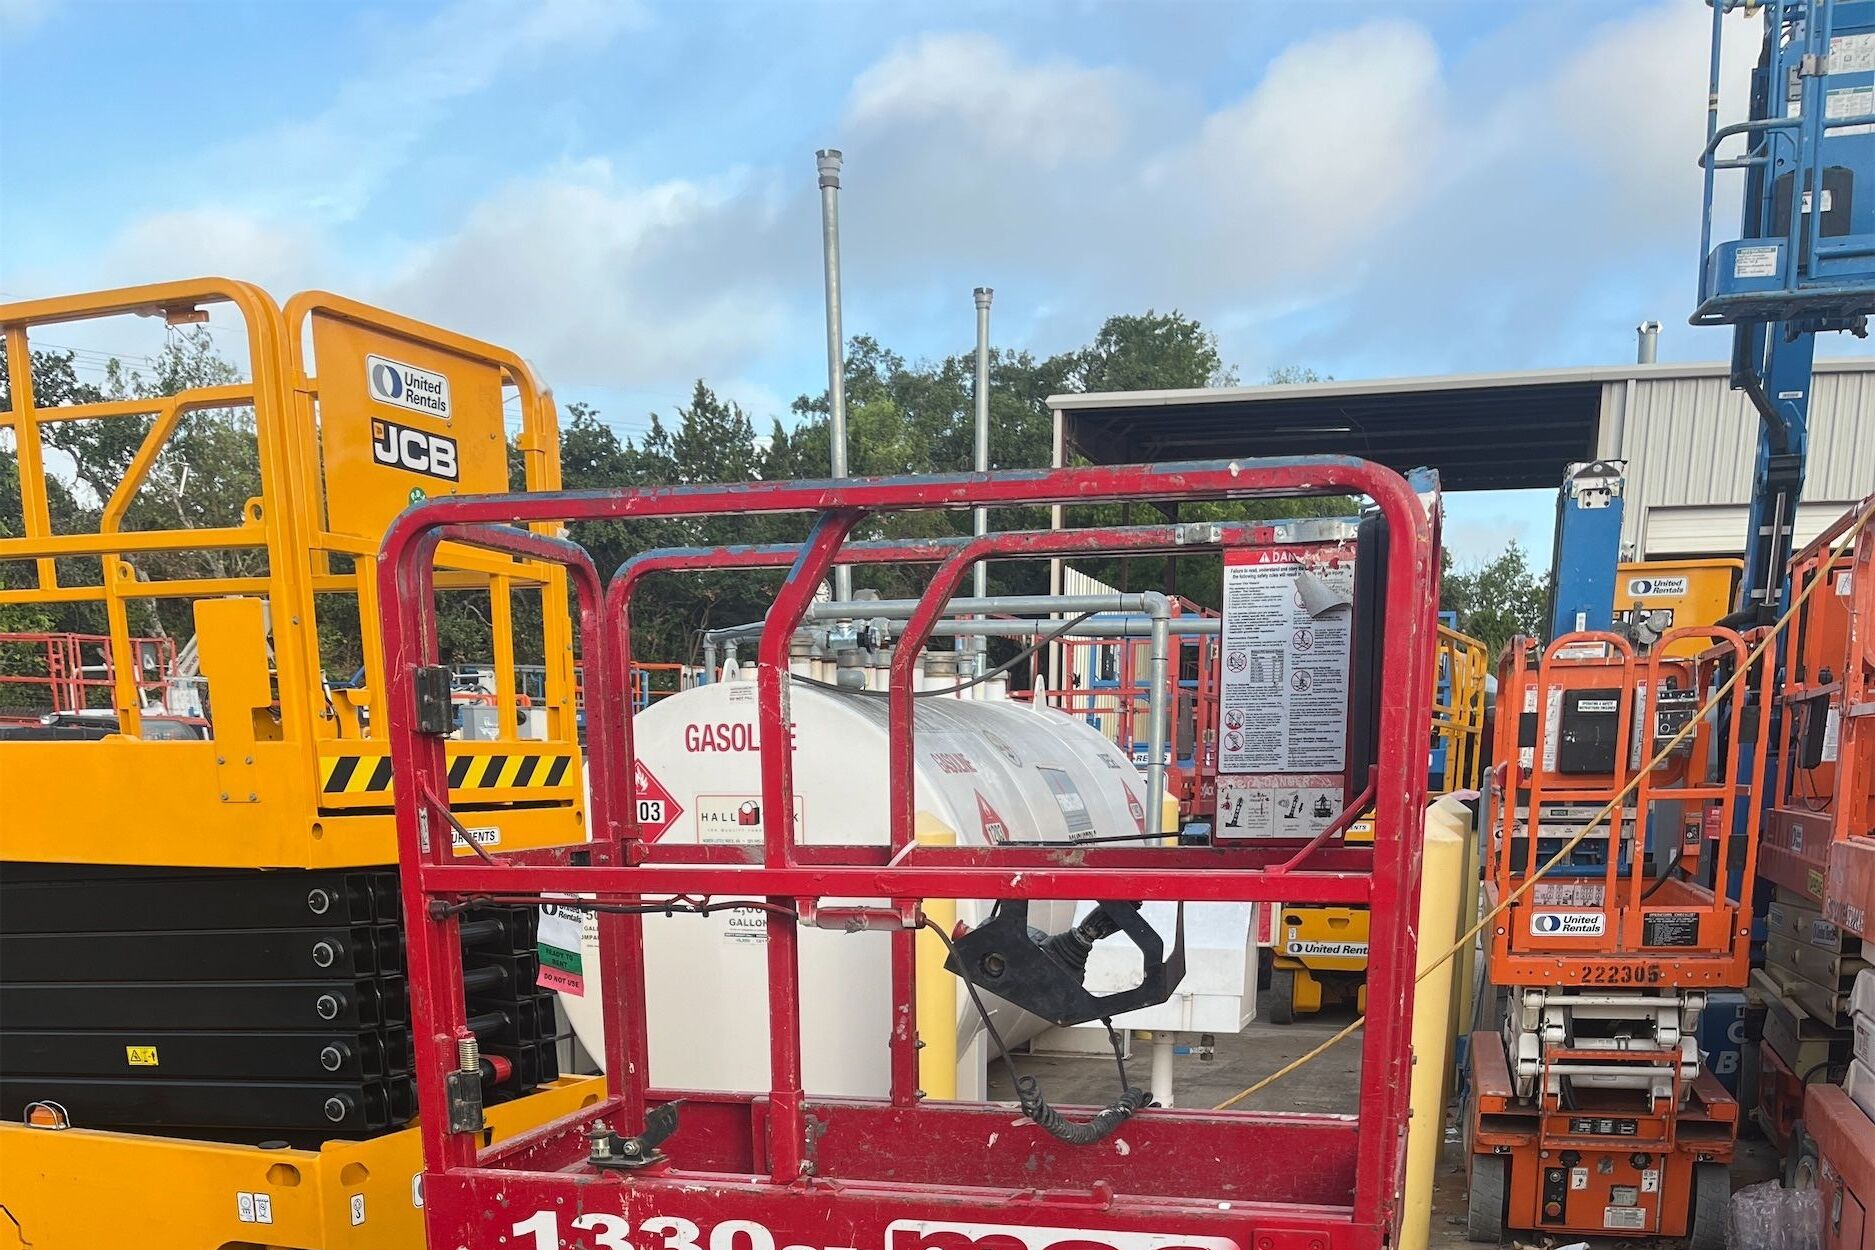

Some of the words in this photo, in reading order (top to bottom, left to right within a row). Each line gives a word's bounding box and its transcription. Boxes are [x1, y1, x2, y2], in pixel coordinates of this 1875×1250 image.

[404, 371, 441, 395] United
[406, 388, 446, 412] Rentals
[374, 425, 457, 477] JCB
[1653, 579, 1682, 587] United
[685, 723, 797, 752] GASOLE
[639, 801, 661, 822] 03
[701, 812, 736, 822] HALL
[559, 910, 582, 924] Rentals
[1563, 915, 1599, 924] United
[1562, 924, 1600, 932] Rentals
[1305, 944, 1342, 954] United
[1342, 945, 1368, 954] Rent
[544, 972, 553, 981] DO
[554, 976, 566, 985] NOT
[567, 979, 580, 988] USE
[1581, 965, 1661, 983] 222305
